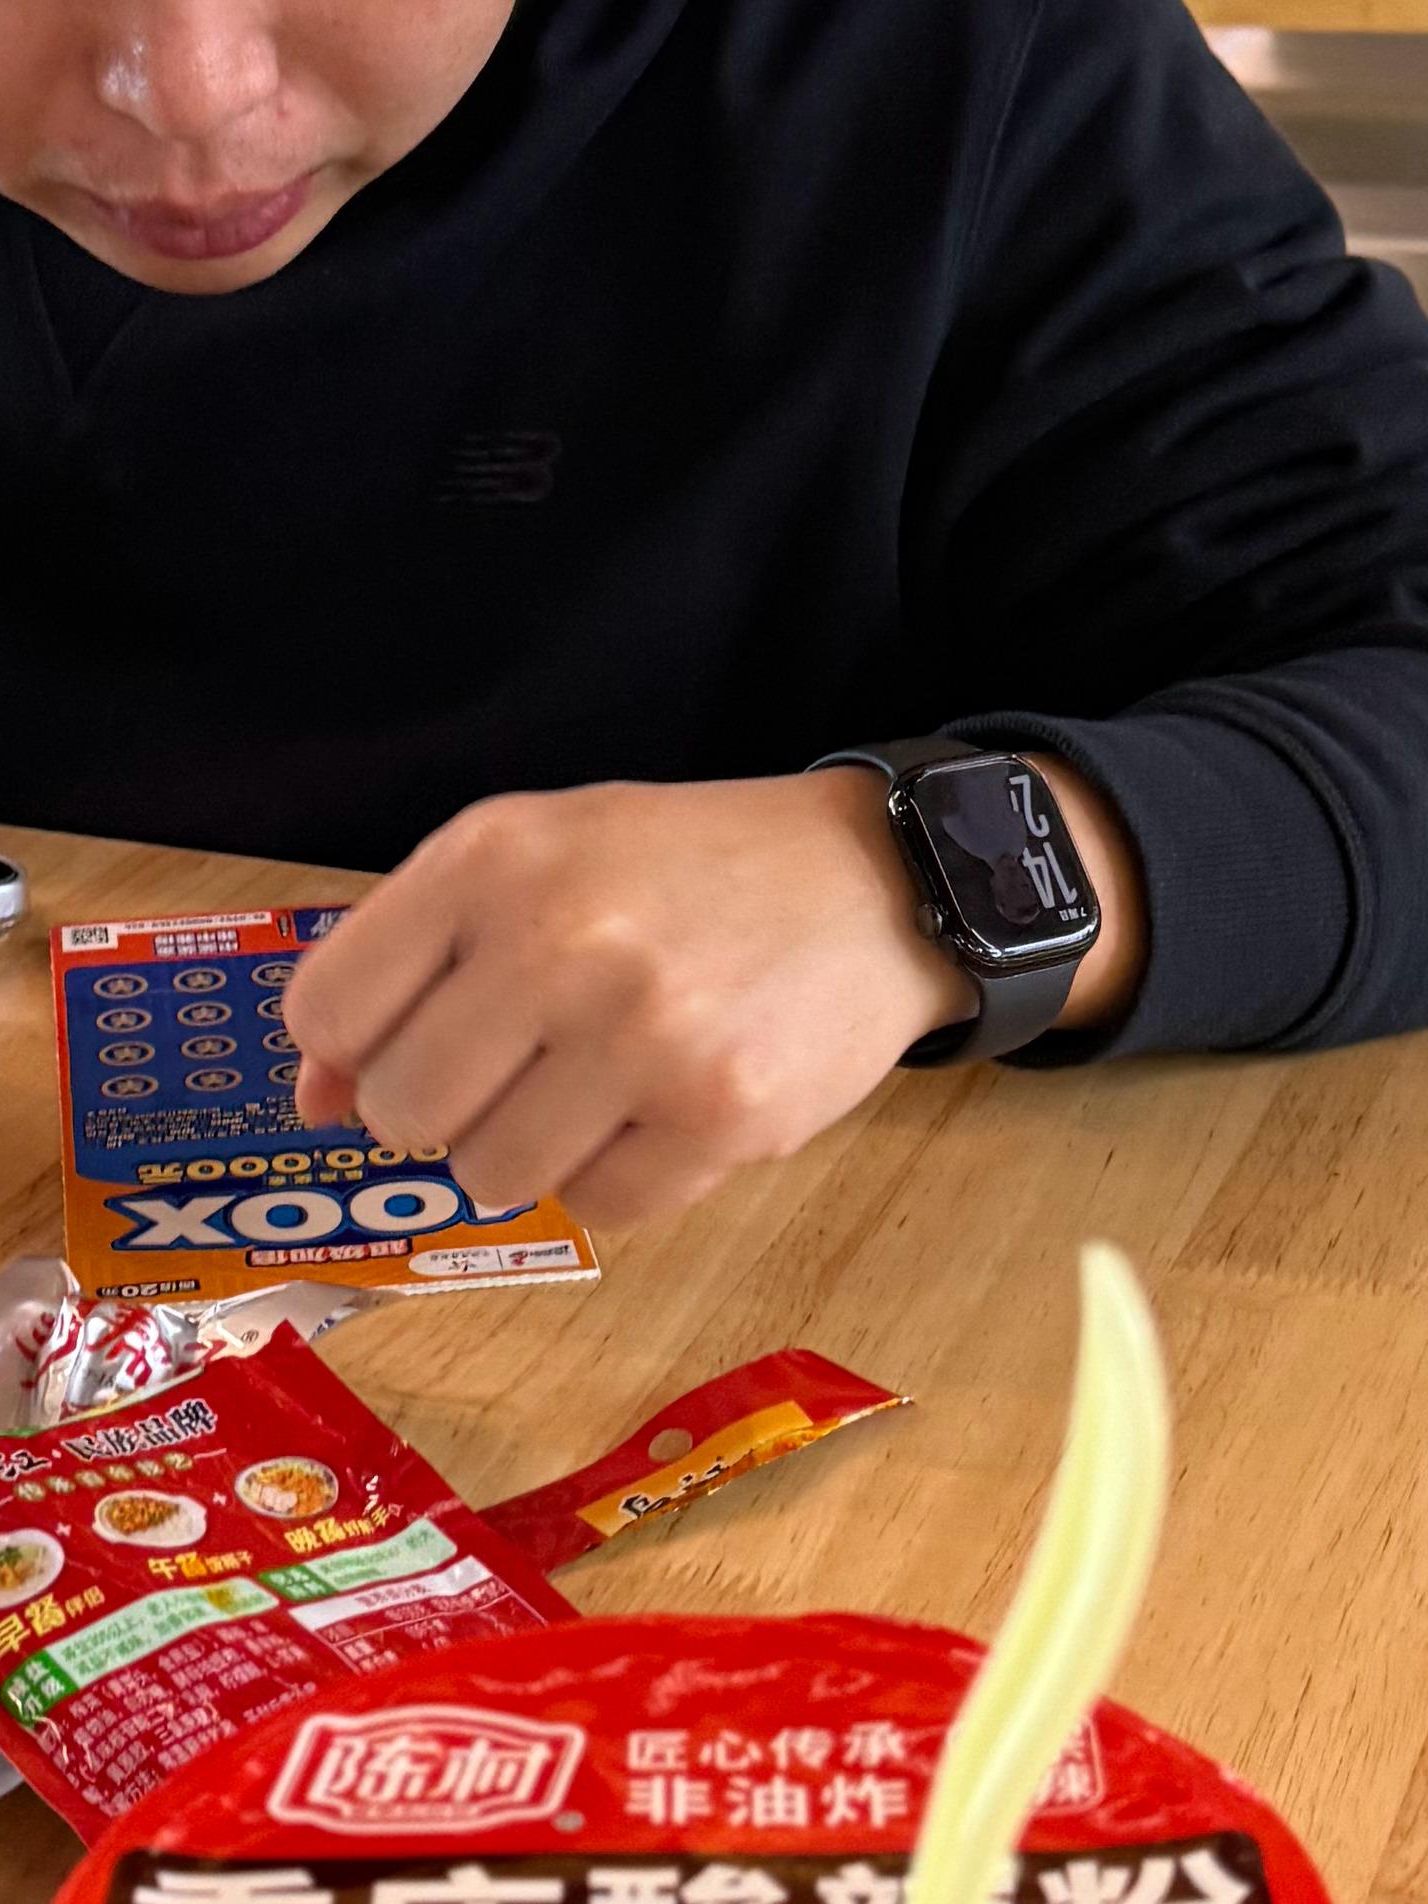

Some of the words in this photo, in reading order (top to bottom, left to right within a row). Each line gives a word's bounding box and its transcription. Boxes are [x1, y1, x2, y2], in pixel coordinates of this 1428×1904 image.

[1022, 841, 1079, 909] 14
[118, 1179, 534, 1248] 00X
[627, 1721, 909, 1773] 匠心传承
[626, 1775, 909, 1828] 非油炸
